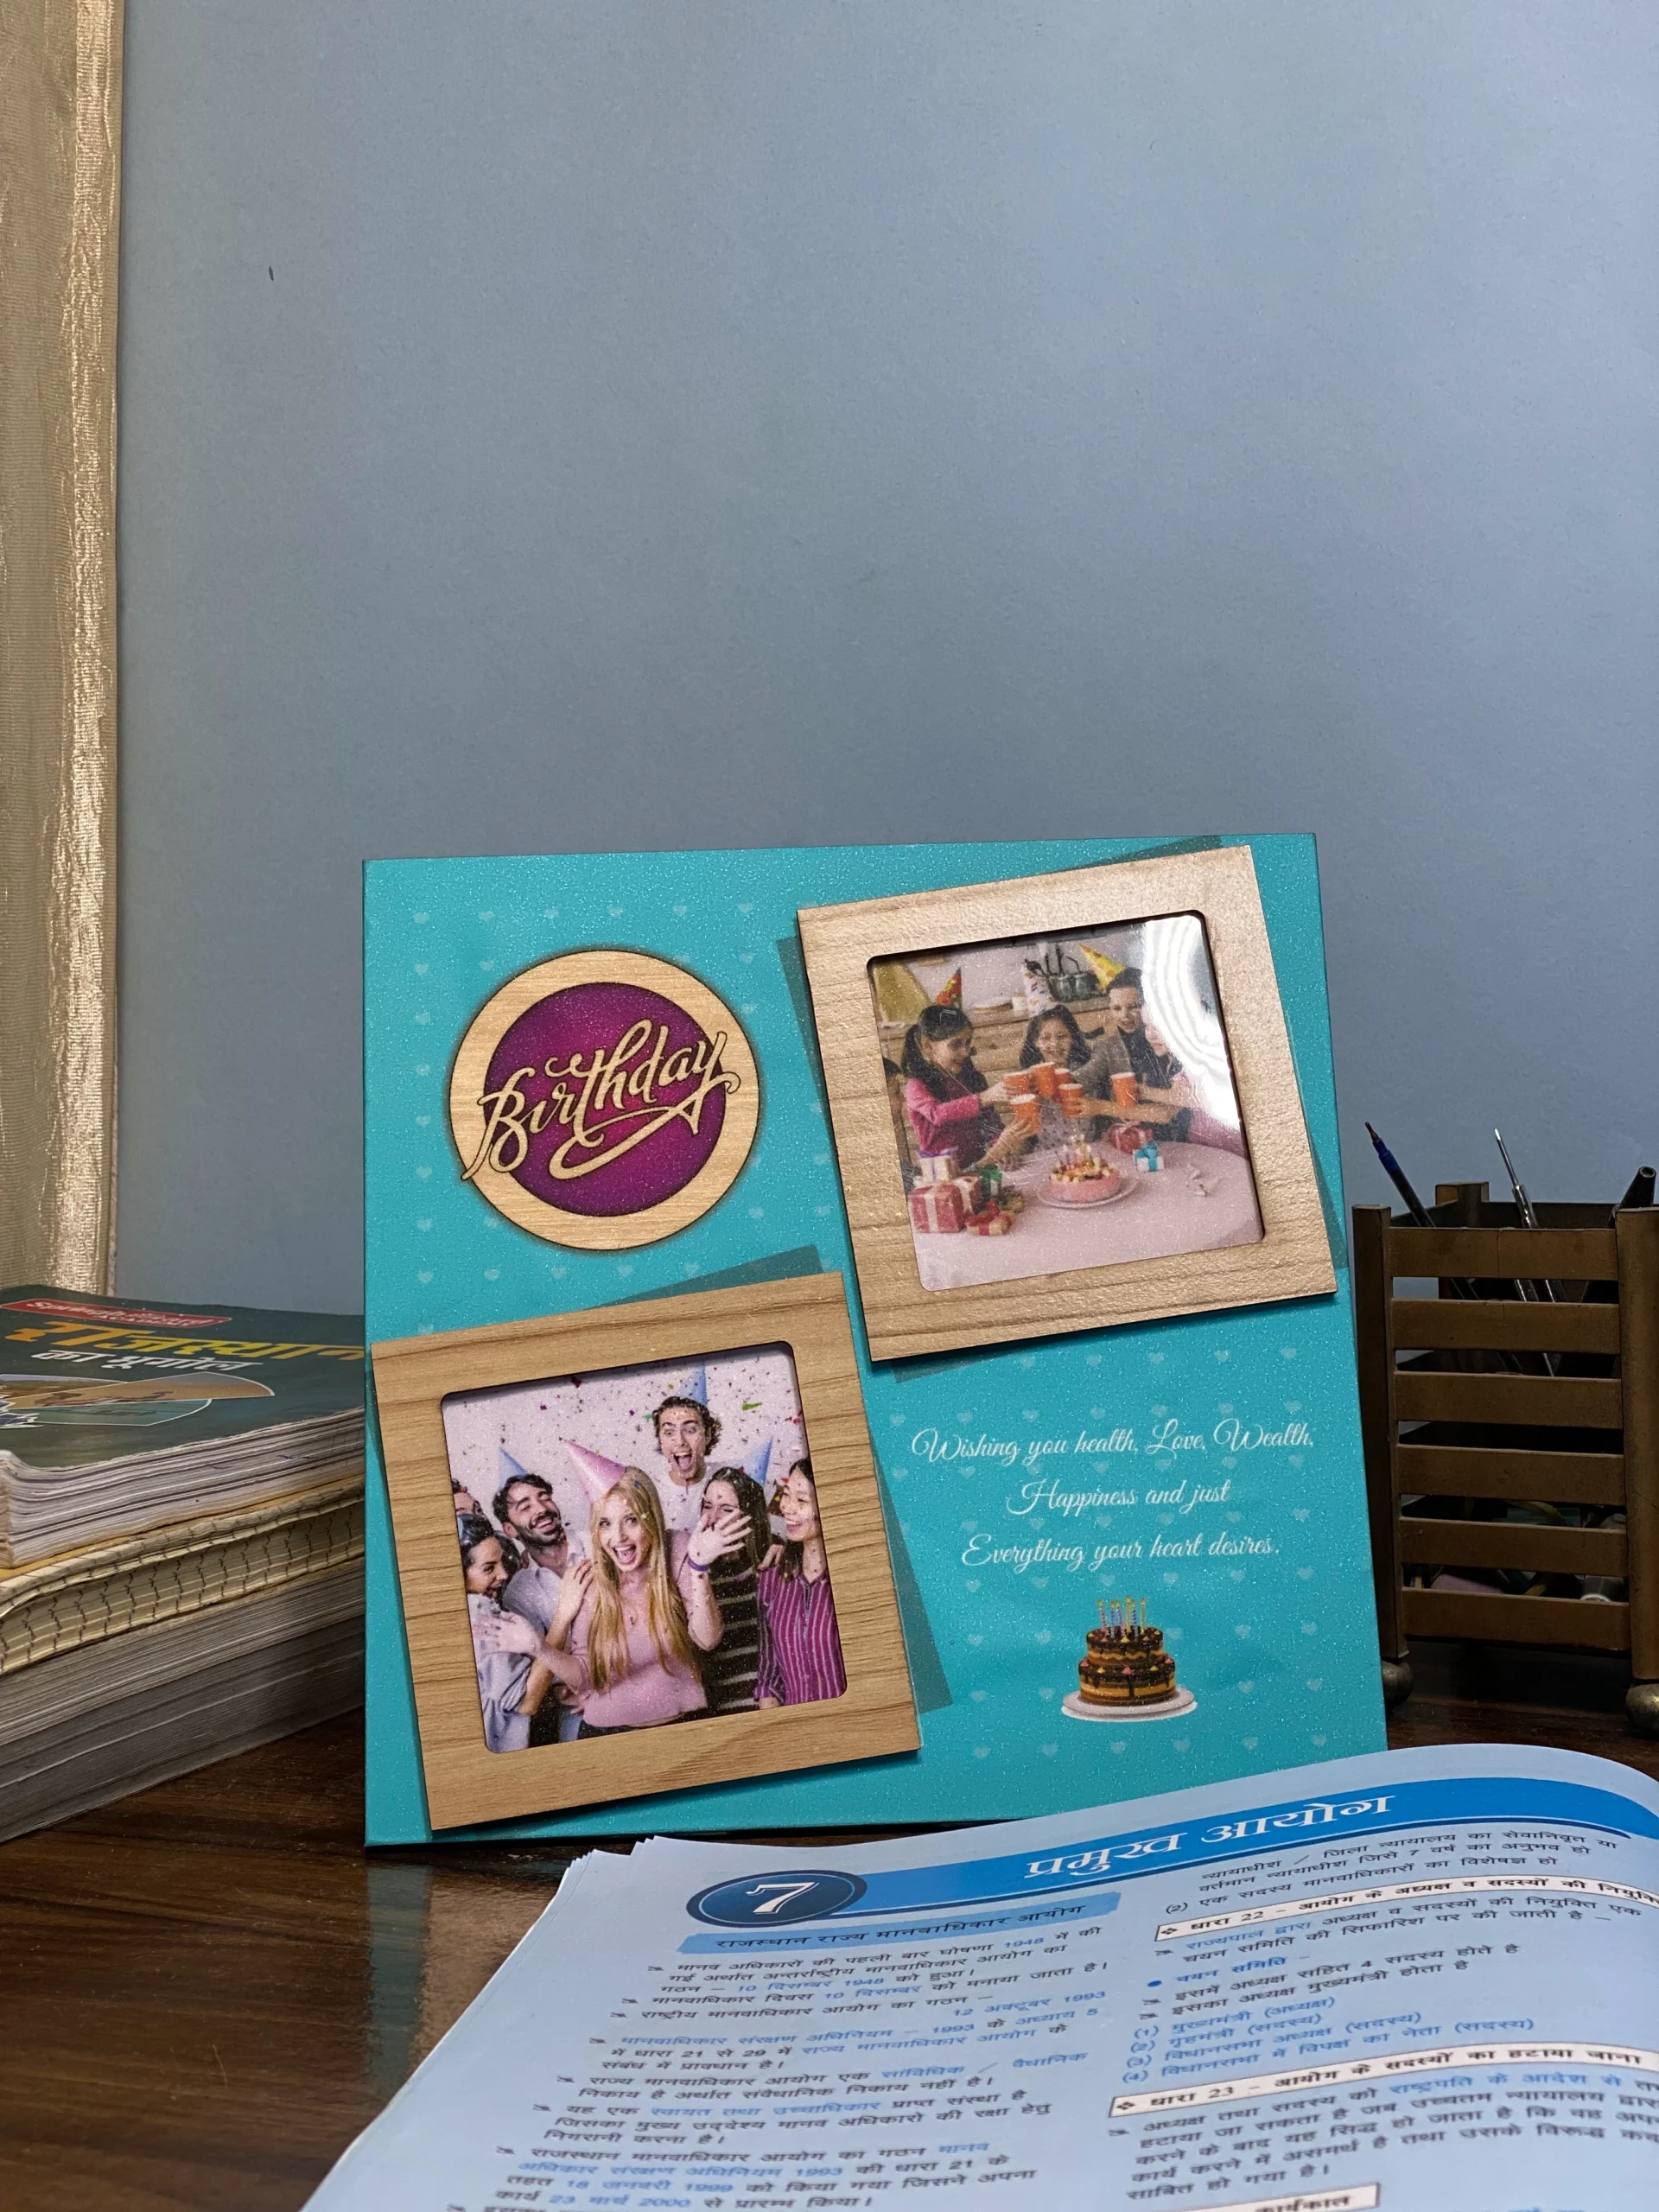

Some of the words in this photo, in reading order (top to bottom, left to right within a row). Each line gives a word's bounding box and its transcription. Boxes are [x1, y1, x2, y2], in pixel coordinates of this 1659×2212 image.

[461, 1019, 741, 1180] Birthday
[4, 1321, 365, 1361] राजस्थान
[30, 1349, 118, 1363] का
[100, 1355, 264, 1371] भूगोल
[912, 1427, 1020, 1466] Wishing
[1022, 1437, 1070, 1466] you
[1006, 1478, 1139, 1517] Happiness
[1145, 1479, 1184, 1505] and
[1178, 1478, 1231, 1515] just
[961, 1533, 1085, 1573] Everything
[1087, 1541, 1145, 1572] your
[1150, 1533, 1204, 1557] heart
[1207, 1531, 1281, 1555] desires.
[1024, 1831, 1188, 1877] प्रमुख
[1200, 1795, 1395, 1843] आयोग
[1202, 1860, 1282, 1878] न्यायाधीश
[1324, 1846, 1369, 1858] जिला
[1378, 1834, 1456, 1847] न्यायालय
[1502, 1830, 1586, 1843] सेवानिवृत
[1596, 1840, 1618, 1849] या
[1166, 1903, 1188, 1914] (2)
[1199, 1896, 1229, 1906] एक
[1238, 1884, 1293, 1897] सदस्य
[1303, 1863, 1414, 1886] मानवाधिकारों
[1460, 1856, 1527, 1866] विशेषज्ञ
[1537, 1856, 1558, 1865] हो
[1199, 1877, 1256, 1891] वर्तमान
[1267, 1859, 1348, 1878] न्यायाधीश
[1358, 1851, 1399, 1864] जिसे
[1430, 1844, 1456, 1853] वर्ष
[1502, 1843, 1560, 1852] अनुभव
[1570, 1846, 1591, 1854] हो
[745, 1881, 819, 1916] 7
[1192, 1918, 1229, 1929] धारा
[1241, 1910, 1264, 1923] 22
[1300, 1896, 1353, 1909] आयोग
[1396, 1884, 1450, 1893] अध्यक्ष
[716, 1937, 811, 1948] राजस्थान
[817, 1933, 869, 1942] राज्य
[876, 1917, 1011, 1937] मानवाधिकार
[1018, 1905, 1085, 1921] आयोग
[1183, 1949, 1228, 1961] चयन
[1237, 1936, 1295, 1952] समिति
[1306, 1930, 1331, 1940] की
[1341, 1917, 1425, 1935] सिफारिश
[1471, 1910, 1498, 1919] की
[1509, 1909, 1557, 1918] जाती
[1567, 1910, 1583, 1920] है
[1185, 1929, 1264, 1949] राज्यपाल
[1275, 1923, 1311, 1934] द्वारा
[1322, 1911, 1378, 1924] अध्यक्ष
[1412, 1898, 1478, 1911] सदस्यों
[1488, 1897, 1514, 1905] की
[1525, 1897, 1598, 1909] नियुक्ति
[1608, 1904, 1641, 1916] एक
[670, 1974, 696, 1982] गई
[703, 1973, 754, 1981] अर्थात
[763, 1968, 855, 1979] अन्तर्राष्ट्रीय
[866, 1959, 968, 1973] मानवाधिकार
[976, 1950, 1033, 1962] आयोग
[1044, 1945, 1068, 1954] का
[729, 1960, 804, 1969] अधिकारों
[845, 1954, 892, 1963] पहली
[939, 1944, 994, 1955] घोषणा
[1005, 1938, 1044, 1948] 1948
[1078, 1927, 1103, 1936] की
[765, 1993, 814, 2002] दिवस
[855, 1986, 922, 1997] दिसम्बर
[932, 1981, 957, 1991] को
[967, 1975, 1020, 1986] मनाया
[1030, 1967, 1074, 1979] जाता
[1084, 1961, 1107, 1972] है।
[767, 1981, 833, 1990] दिसम्बर
[896, 1973, 920, 1982] को
[930, 1969, 974, 1981] हुआ।
[1172, 1999, 1229, 2015] इसका
[1238, 1987, 1297, 2002] अध्यक्ष
[1306, 1970, 1389, 1993] मुख्यमंत्री
[1400, 1965, 1443, 1976] होता
[1454, 1960, 1469, 1970] है
[1175, 1970, 1219, 1982] चयन
[1230, 1957, 1287, 1973] समिति
[1175, 1985, 1220, 2000] इसमें
[1230, 1974, 1287, 1990] अध्यक्ष
[1297, 1964, 1351, 1978] सहित
[1384, 1951, 1445, 1964] सदस्य
[1456, 1945, 1493, 1956] होते
[1504, 1943, 1520, 1954] है
[641, 2010, 698, 2019] राष्ट्रीय
[709, 2008, 813, 2018] मानवाधिकार
[822, 2004, 881, 2013] आयोग
[925, 1997, 969, 2005] गठन
[984, 1999, 1051, 2012] अक्टूबर
[1064, 1991, 1105, 2003] 1993
[1135, 2025, 1159, 2038] (1)
[1172, 2012, 1252, 2034] मुख्यमंत्री
[1264, 1997, 1335, 2018] (अध्यक्ष)
[1122, 2070, 1148, 2083] (4)
[1161, 2055, 1261, 2076] विधानसभा
[1272, 2048, 1287, 2057] में
[1299, 2039, 1351, 2055] विपक्ष
[1363, 2034, 1389, 2043] का
[1402, 2026, 1441, 2037] नेता
[1454, 2018, 1534, 2033] (सदस्य)
[1127, 2055, 1152, 2068] (3)
[1165, 2039, 1262, 2061] विधानसभा
[1274, 2028, 1332, 2043] अध्यक्ष
[1345, 2012, 1421, 2033] (सदस्य)
[1130, 2040, 1155, 2053] (2)
[1169, 2028, 1235, 2048] गृहमंत्री
[1248, 2013, 1321, 2035] (सदस्य)
[1151, 2094, 1196, 2105] धारा
[1209, 2087, 1233, 2098] 23
[1275, 2071, 1338, 2086] आयोग
[1352, 2064, 1370, 2074] के
[1386, 2053, 1452, 2069] सदस्यों
[1588, 2052, 1640, 2063] जाना
